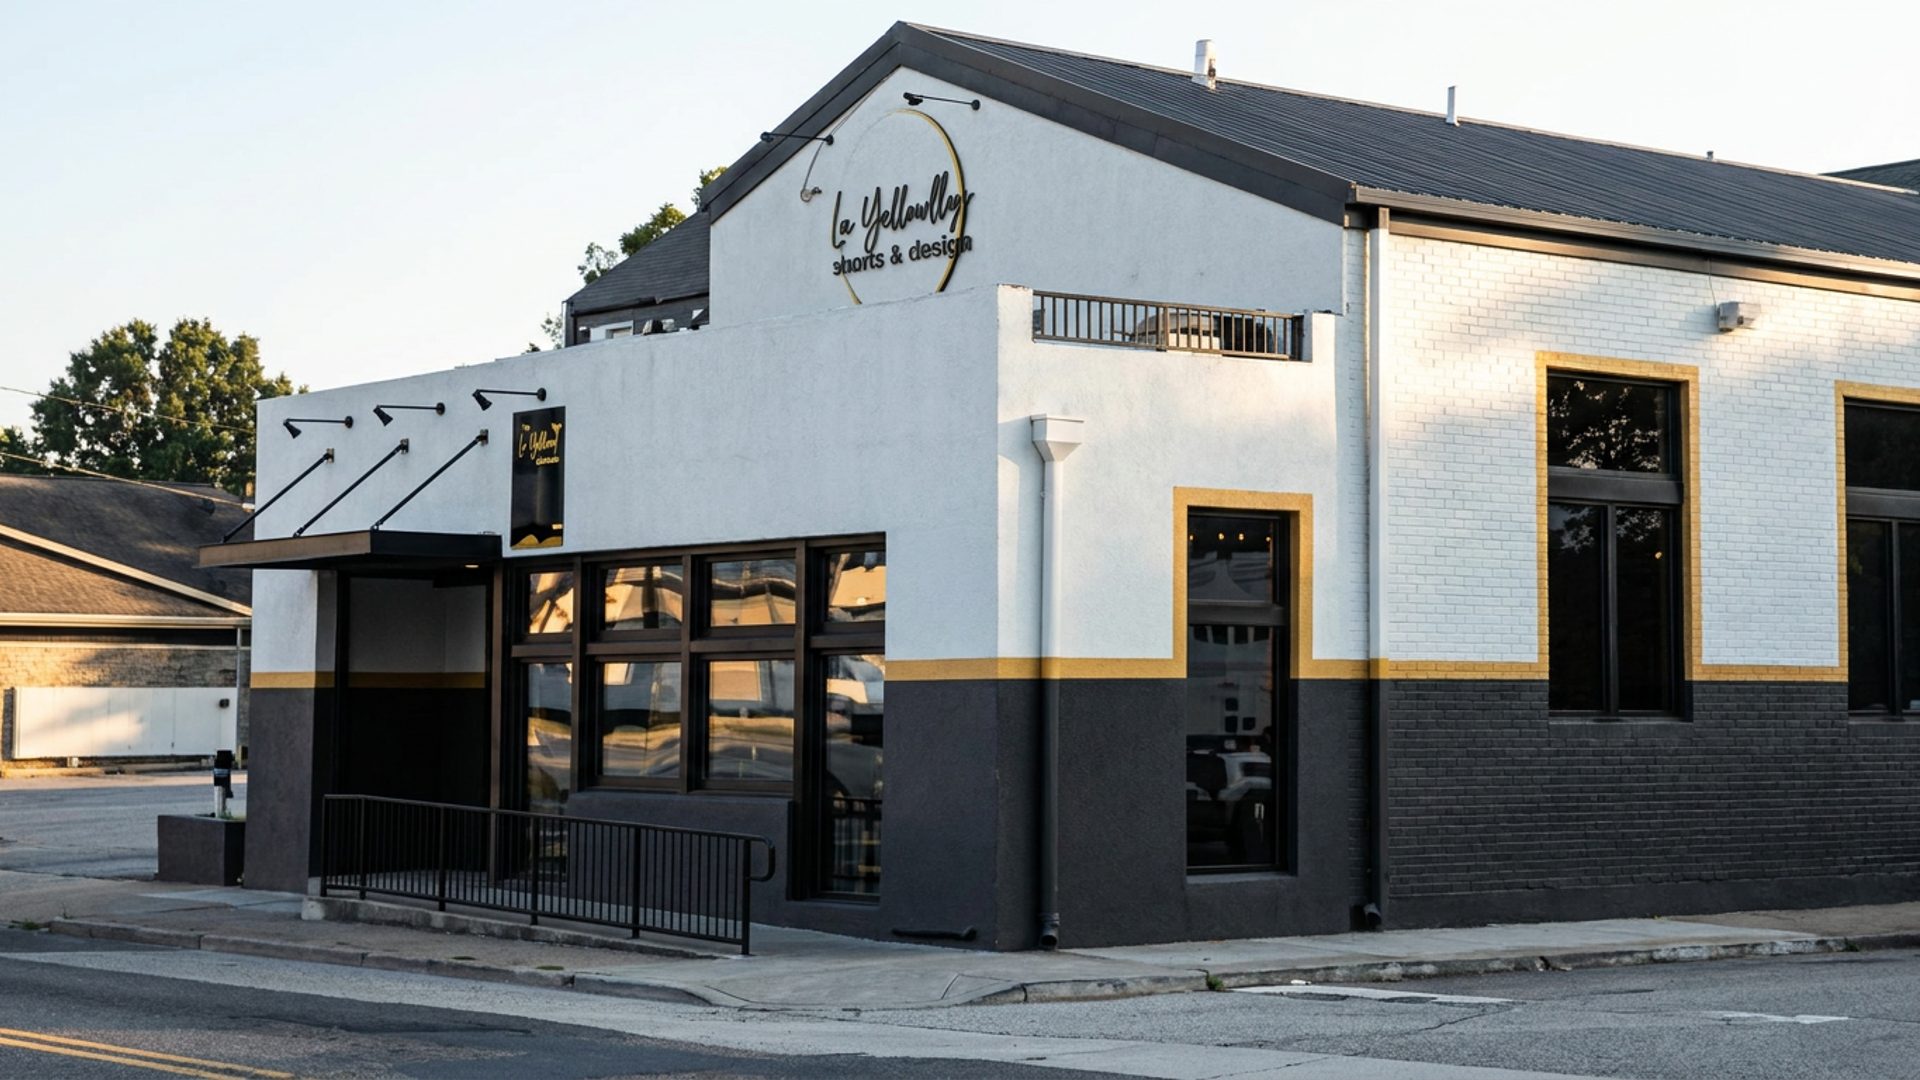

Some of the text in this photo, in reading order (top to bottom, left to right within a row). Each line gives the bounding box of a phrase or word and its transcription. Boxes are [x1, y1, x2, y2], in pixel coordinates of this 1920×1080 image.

[832, 191, 856, 249] La
[890, 244, 903, 265] &
[909, 234, 973, 261] design
